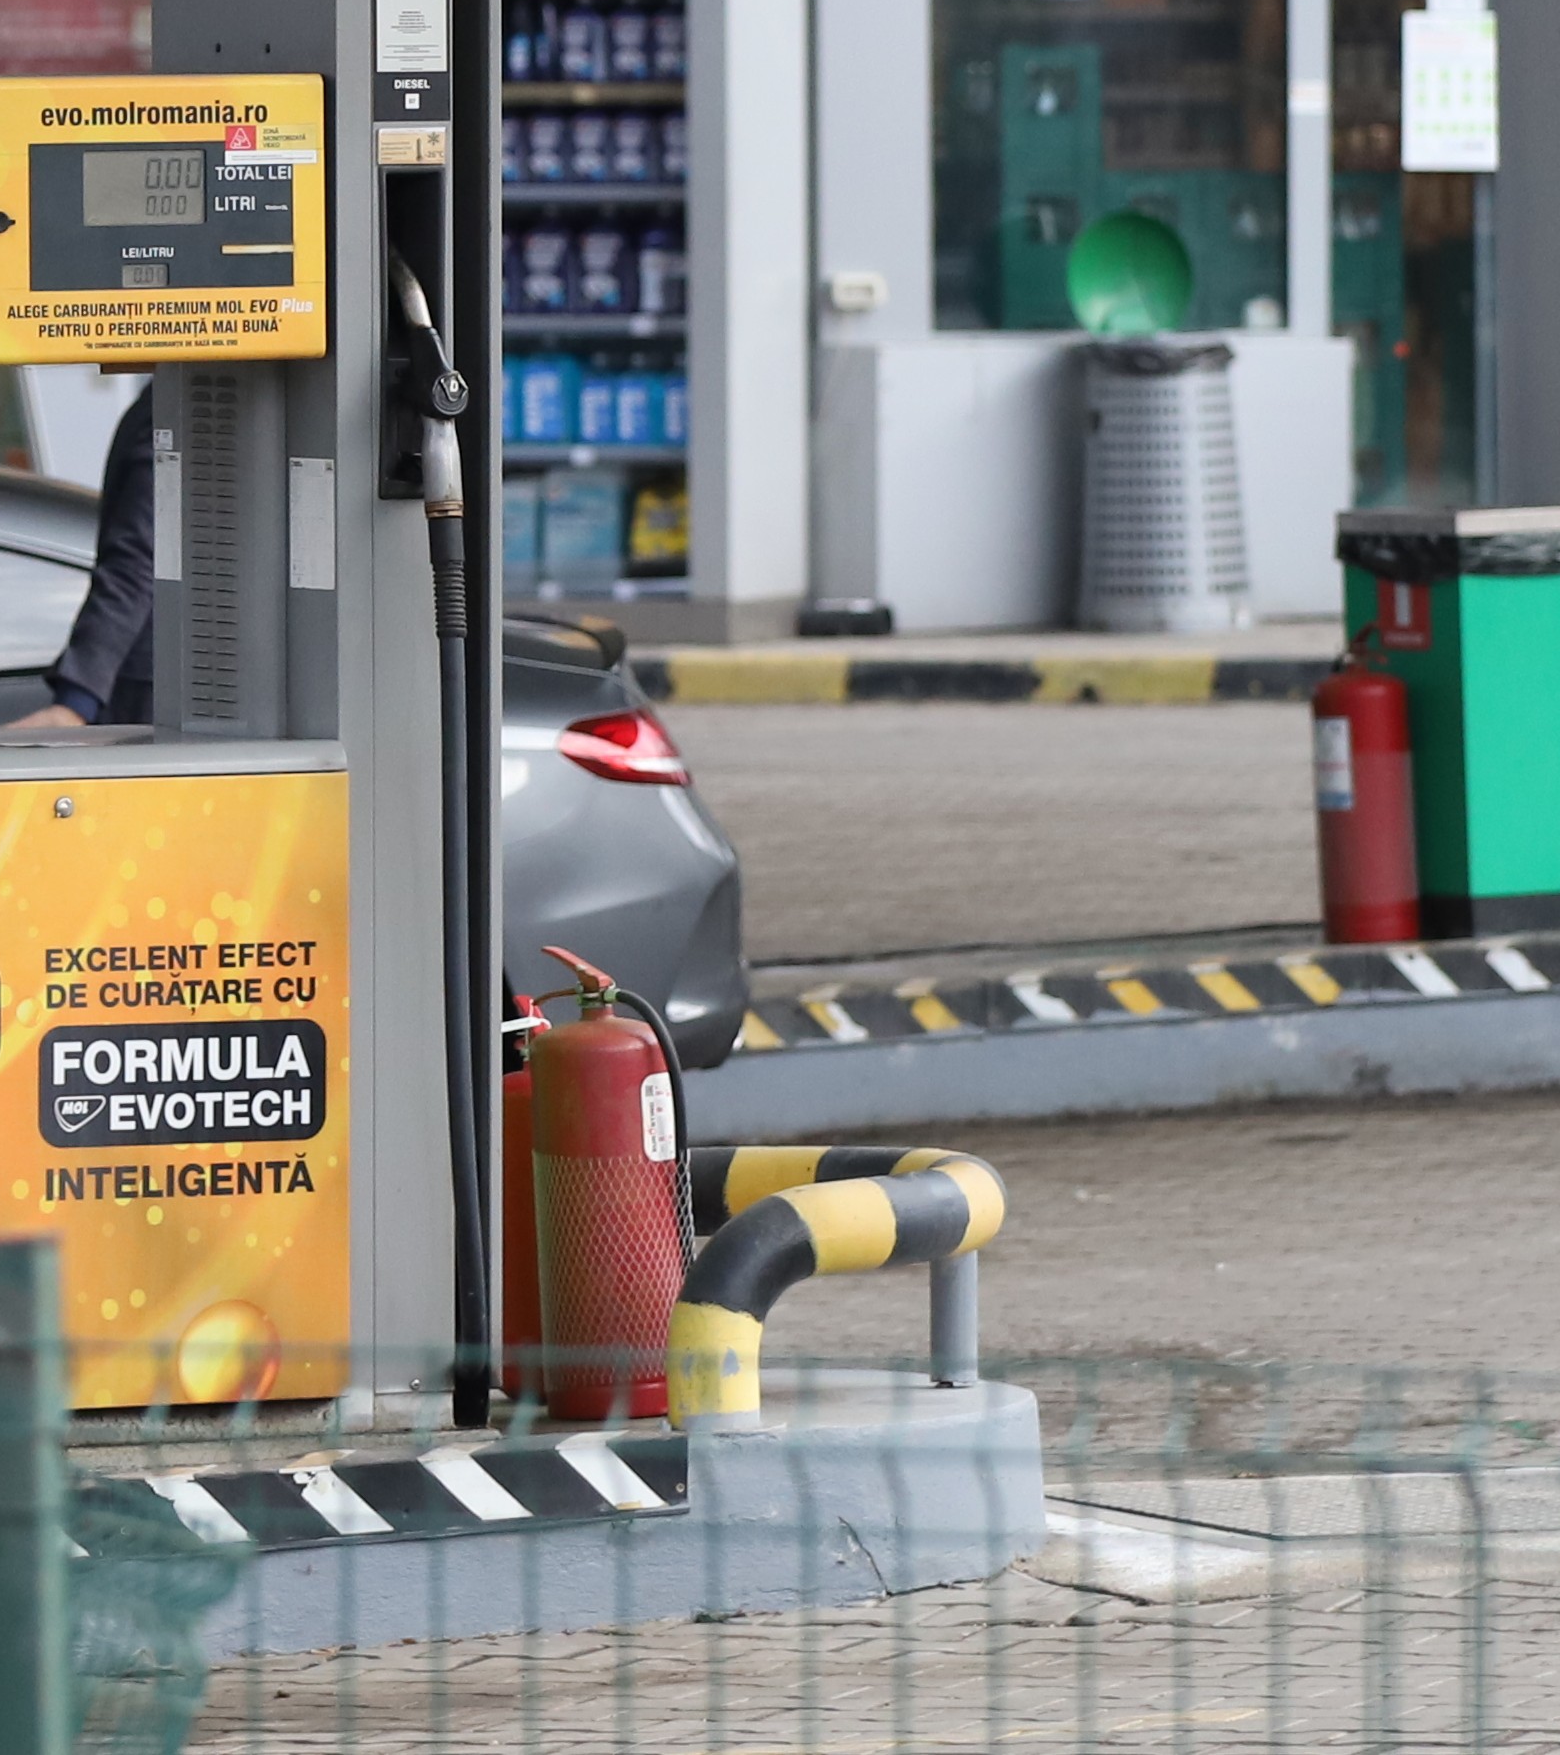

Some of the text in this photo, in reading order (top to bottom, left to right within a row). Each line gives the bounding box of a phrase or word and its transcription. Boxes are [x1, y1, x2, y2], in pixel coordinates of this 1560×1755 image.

[394, 79, 431, 90] DIESEL
[40, 100, 269, 127] evo.molromania.ro
[215, 166, 291, 181] TOTAL LEI
[215, 196, 256, 211] LITRI
[122, 247, 175, 258] LEI/LITRU
[7, 304, 49, 319] ALEGE
[148, 300, 212, 316] PREMIUM
[216, 299, 245, 314] MOL
[249, 299, 278, 313] EVO
[281, 298, 314, 313] Plus
[38, 323, 91, 338] PENTRU
[95, 323, 104, 337] O
[109, 318, 207, 338] PERFORMANȚĂ
[212, 319, 238, 333] MAI
[450, 380, 459, 392] D
[45, 941, 317, 973] EXCELENT EFECT
[46, 972, 317, 1015] DE CURĂȚARE CU
[53, 1035, 311, 1085] FORMULA
[61, 1089, 311, 1131] MOL EVOTECH
[45, 1152, 315, 1201] INTELIGENTĂ
